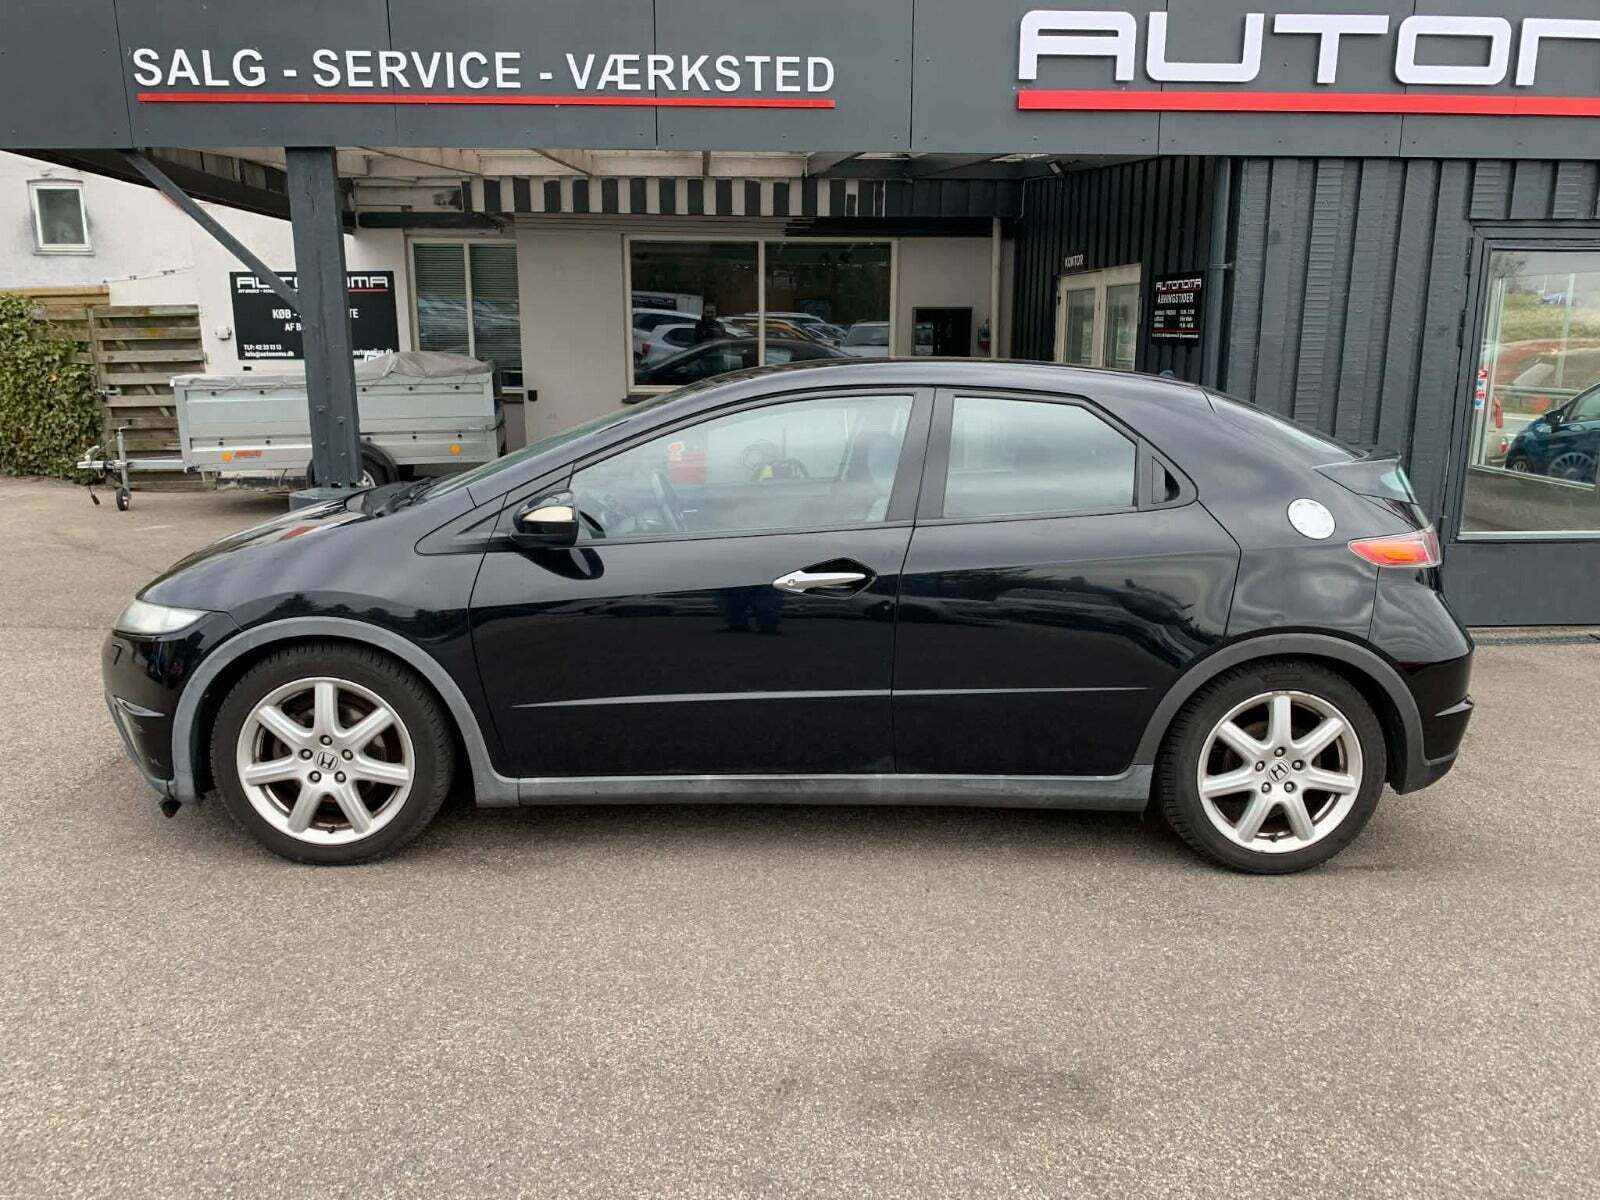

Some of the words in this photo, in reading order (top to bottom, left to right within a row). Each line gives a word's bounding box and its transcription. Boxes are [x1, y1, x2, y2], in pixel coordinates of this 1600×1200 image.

[133, 48, 266, 87] SALG
[312, 49, 521, 88] SERVICE
[566, 53, 835, 92] VÆRKSTED
[1155, 278, 1202, 292] AUTONOMA
[272, 308, 291, 319] KØB
